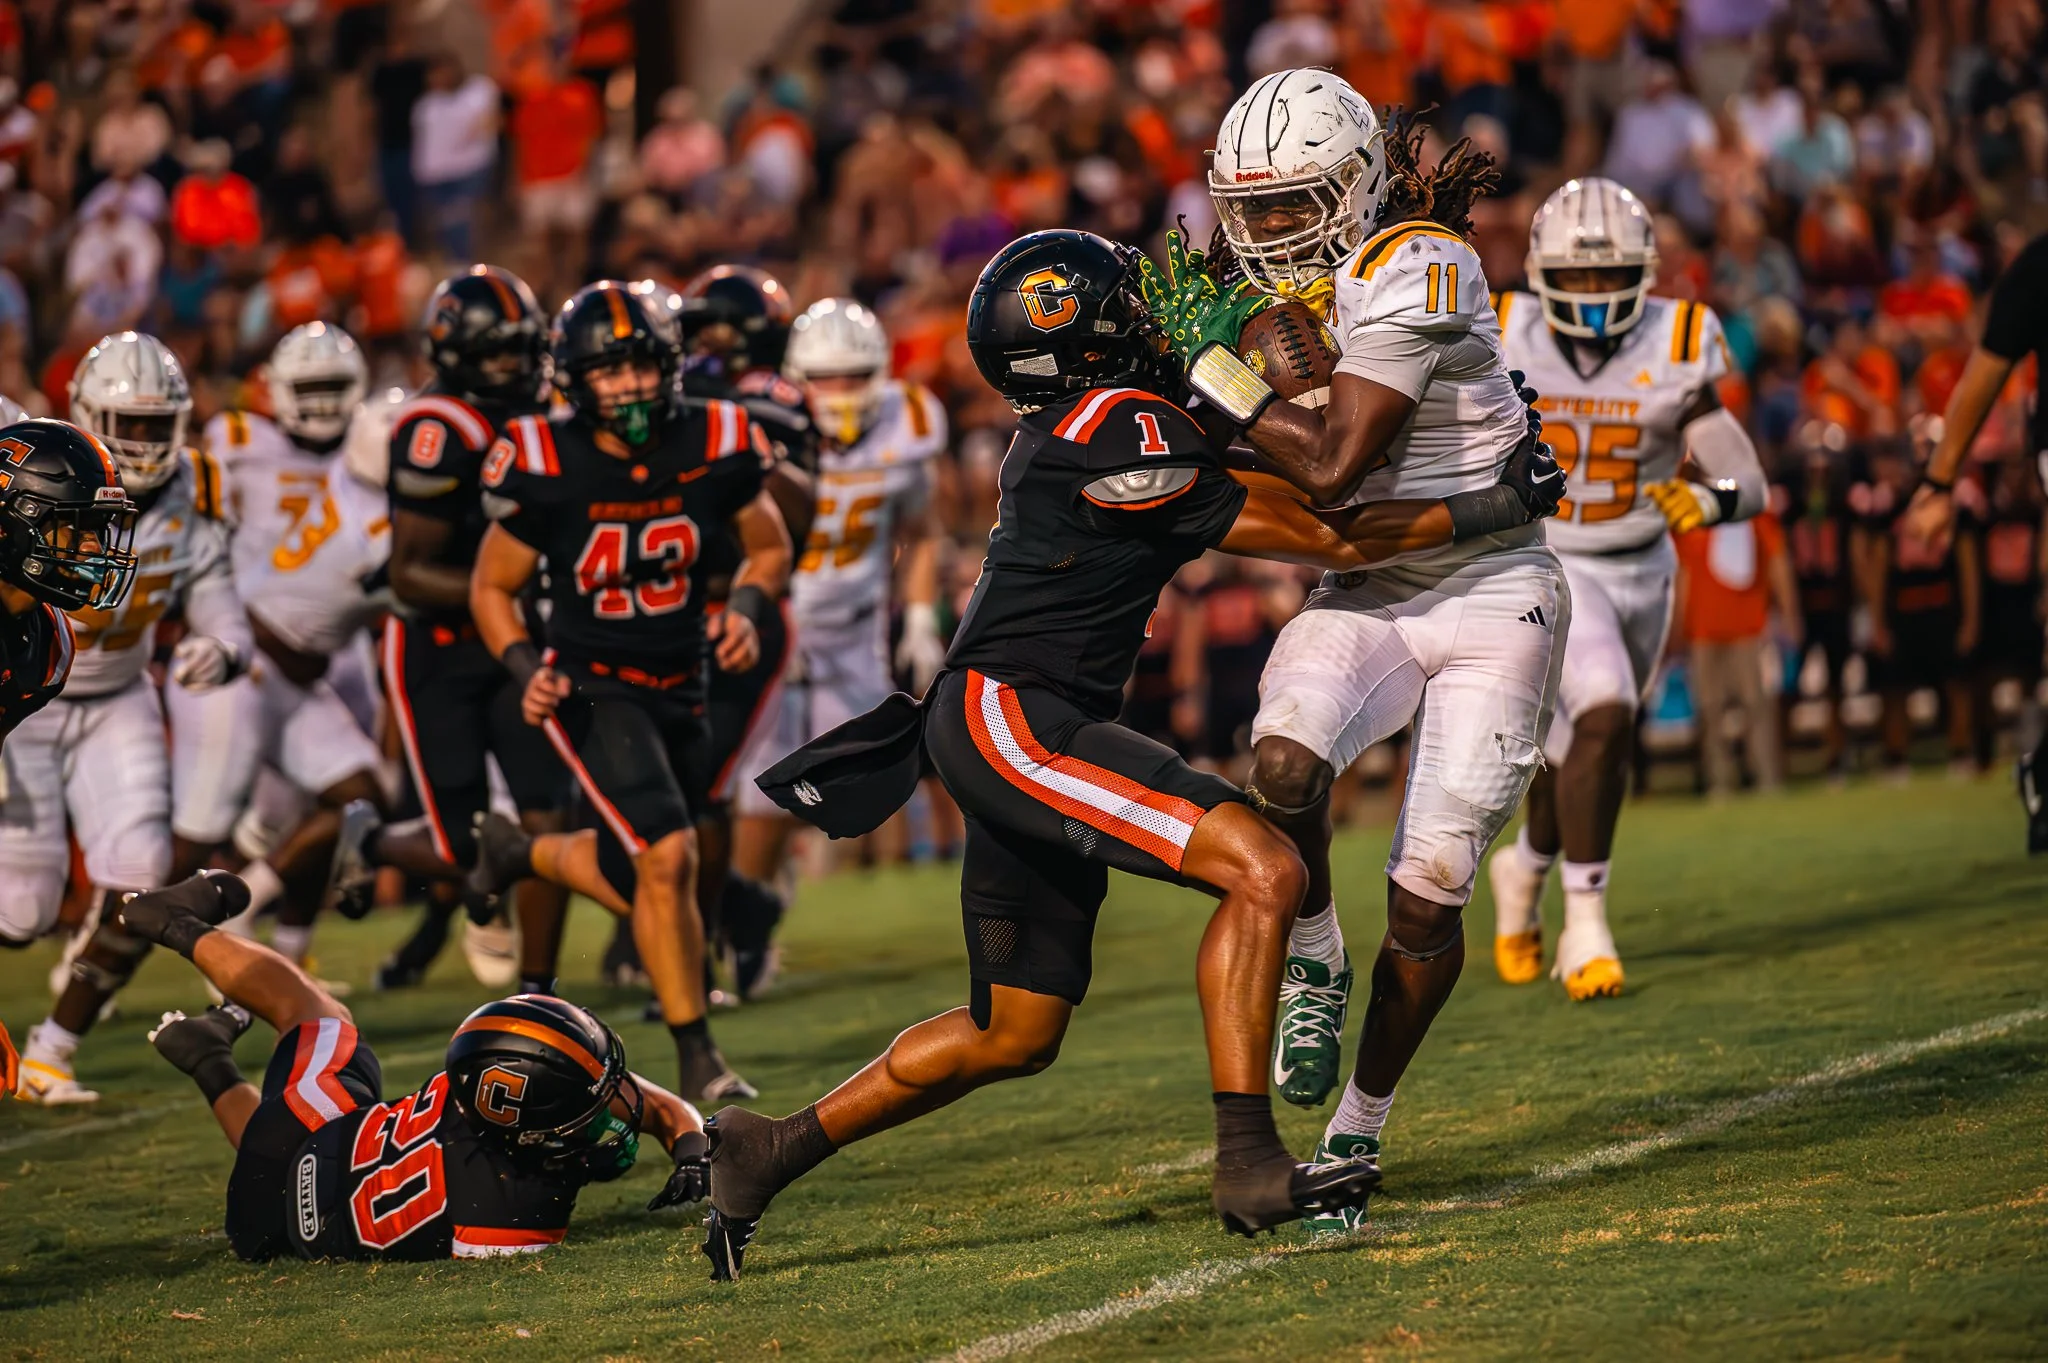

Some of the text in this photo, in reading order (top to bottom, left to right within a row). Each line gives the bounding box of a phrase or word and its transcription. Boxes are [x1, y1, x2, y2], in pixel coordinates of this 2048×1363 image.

[1017, 263, 1081, 333] C
[1425, 263, 1459, 314] 11
[408, 419, 448, 470] 8
[1134, 412, 1170, 456] 1
[573, 514, 700, 619] 43
[475, 1065, 528, 1126] C
[350, 1071, 450, 1250] 20
[301, 1161, 315, 1235] BATTLE
